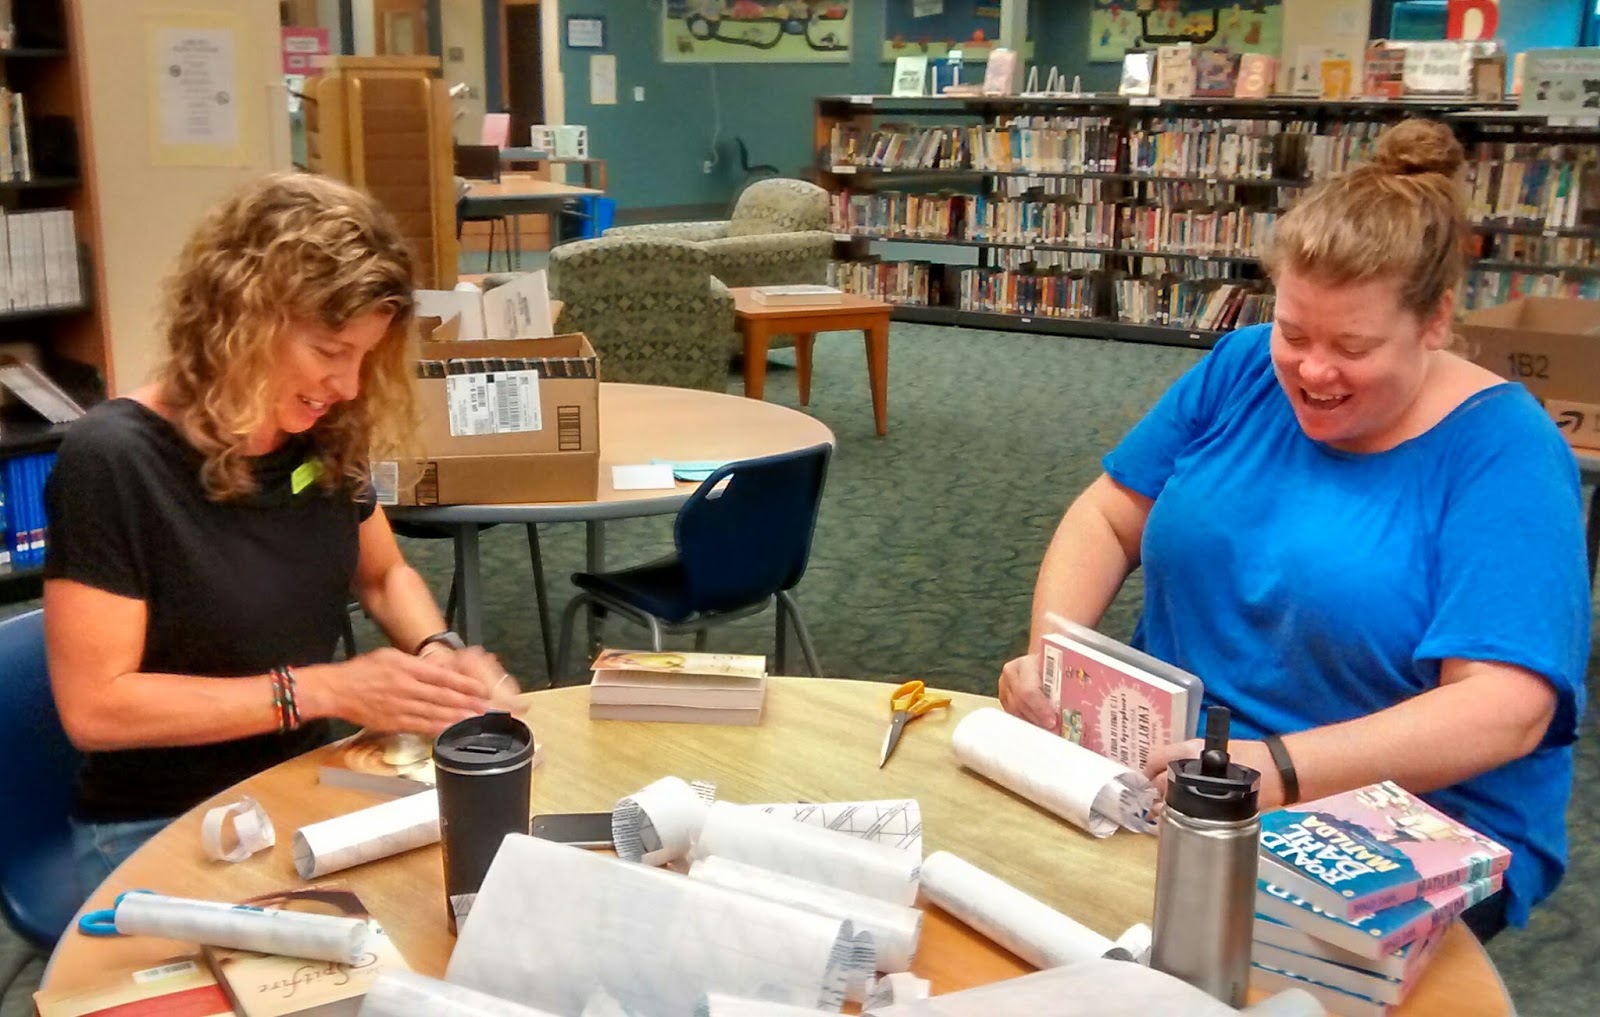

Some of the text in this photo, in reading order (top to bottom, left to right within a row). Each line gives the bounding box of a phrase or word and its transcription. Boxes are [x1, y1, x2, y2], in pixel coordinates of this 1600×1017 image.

[1507, 352, 1550, 379] 1B2
[1119, 693, 1130, 744] completely
[1138, 705, 1150, 769] EVERYTHING
[1259, 831, 1352, 885] ROALD
[1281, 823, 1377, 879] DAHL
[1301, 815, 1401, 873] MATILDA
[257, 952, 377, 999] Spitfire
